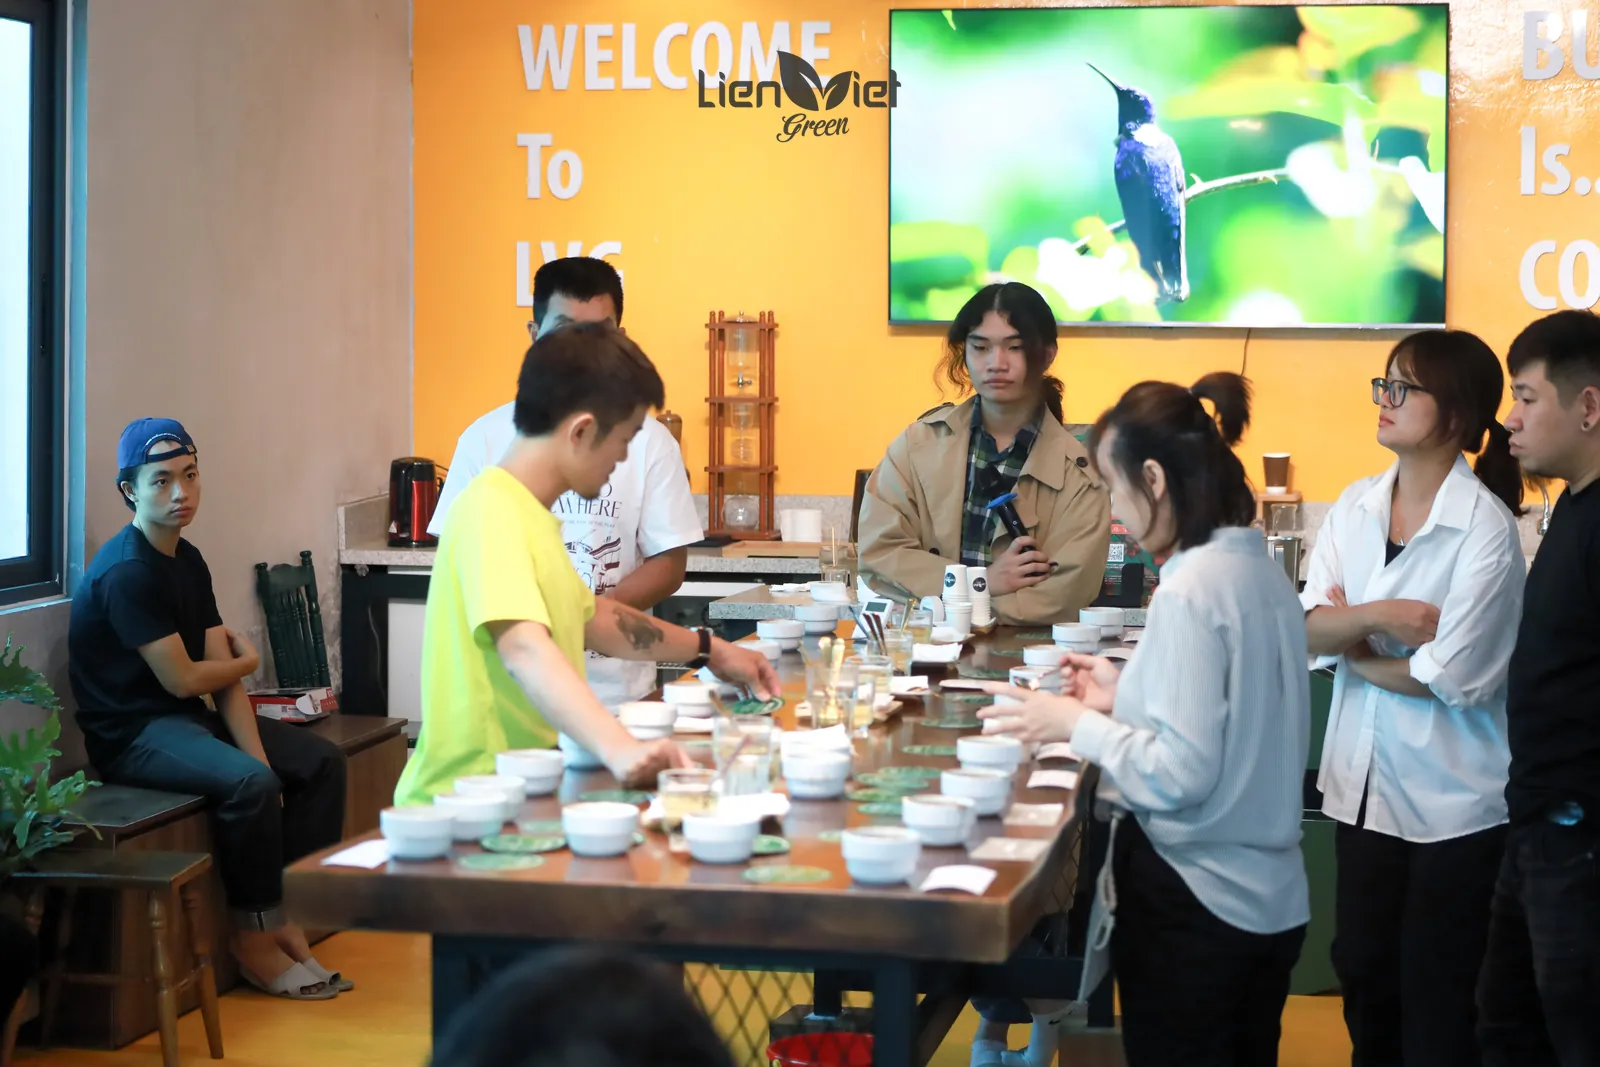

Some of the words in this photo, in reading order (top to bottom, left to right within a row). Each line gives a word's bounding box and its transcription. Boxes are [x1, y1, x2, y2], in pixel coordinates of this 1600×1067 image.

[517, 21, 831, 90] WELCOME
[516, 133, 583, 199] To
[1520, 125, 1600, 196] Is.
[1518, 239, 1600, 311] CO
